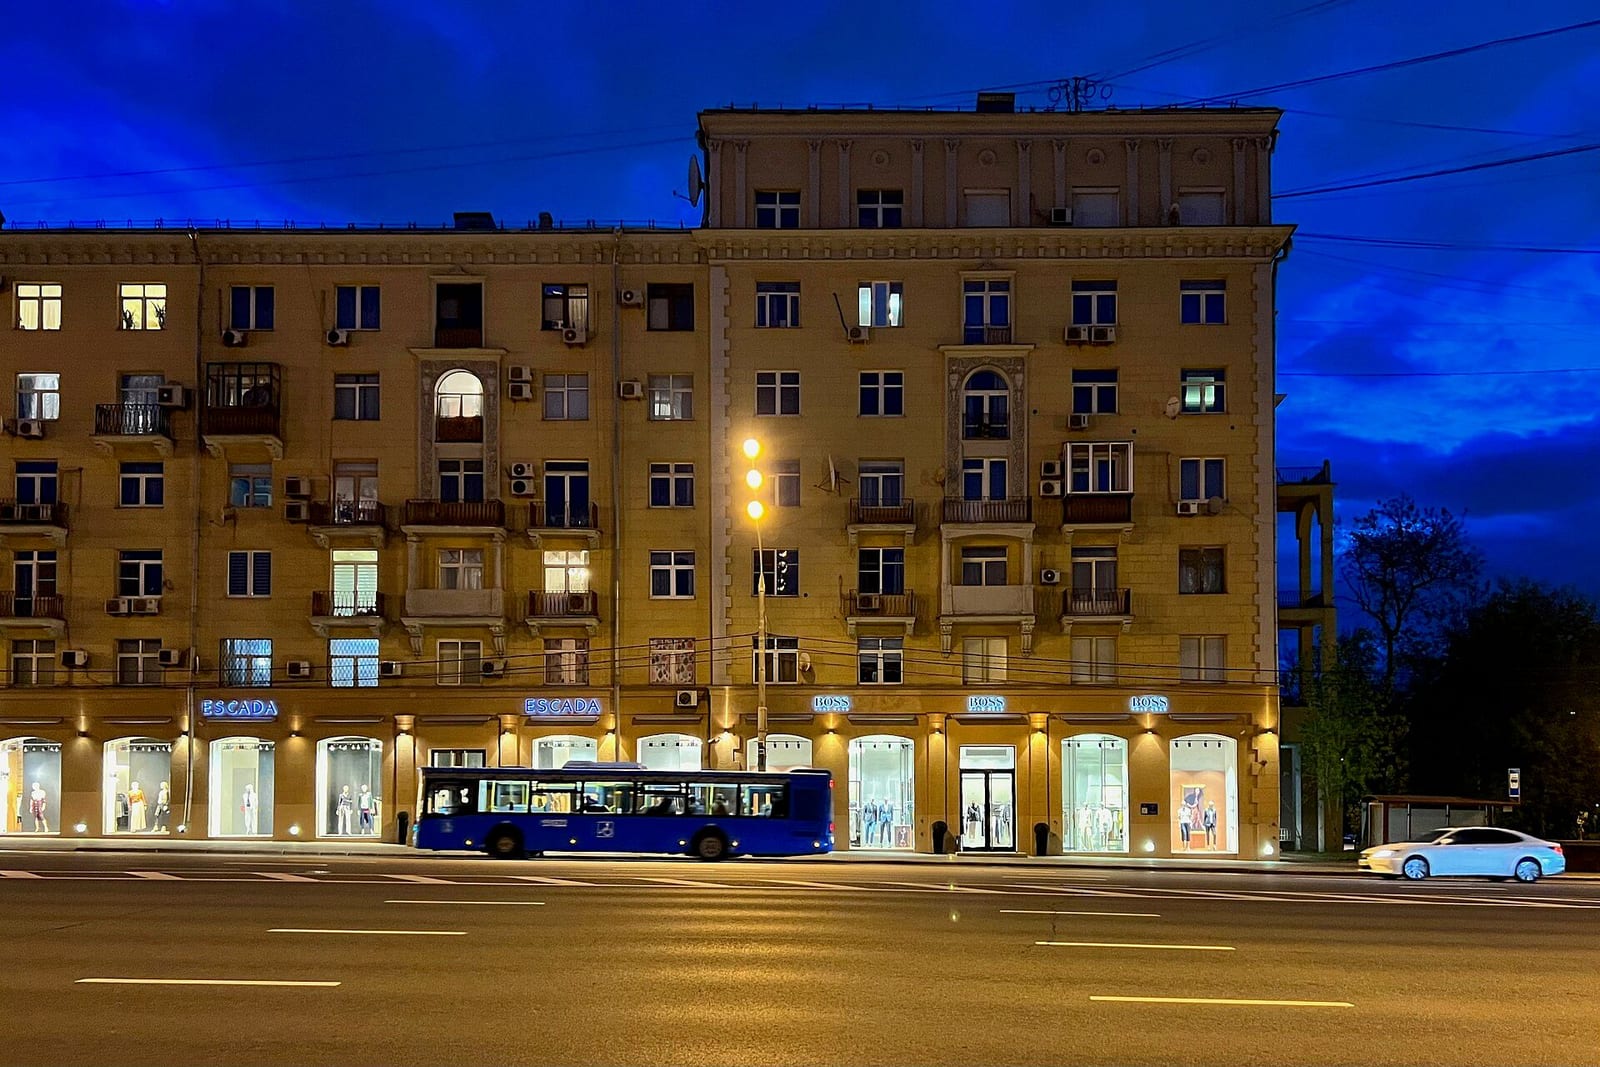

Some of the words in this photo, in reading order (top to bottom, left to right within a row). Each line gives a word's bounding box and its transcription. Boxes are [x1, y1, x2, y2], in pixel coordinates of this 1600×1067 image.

[525, 698, 601, 714] ESCADA
[814, 696, 849, 707] BOSS
[969, 696, 1004, 707] BOSS
[1131, 696, 1167, 707] BOSS
[202, 699, 278, 716] ESCADA
